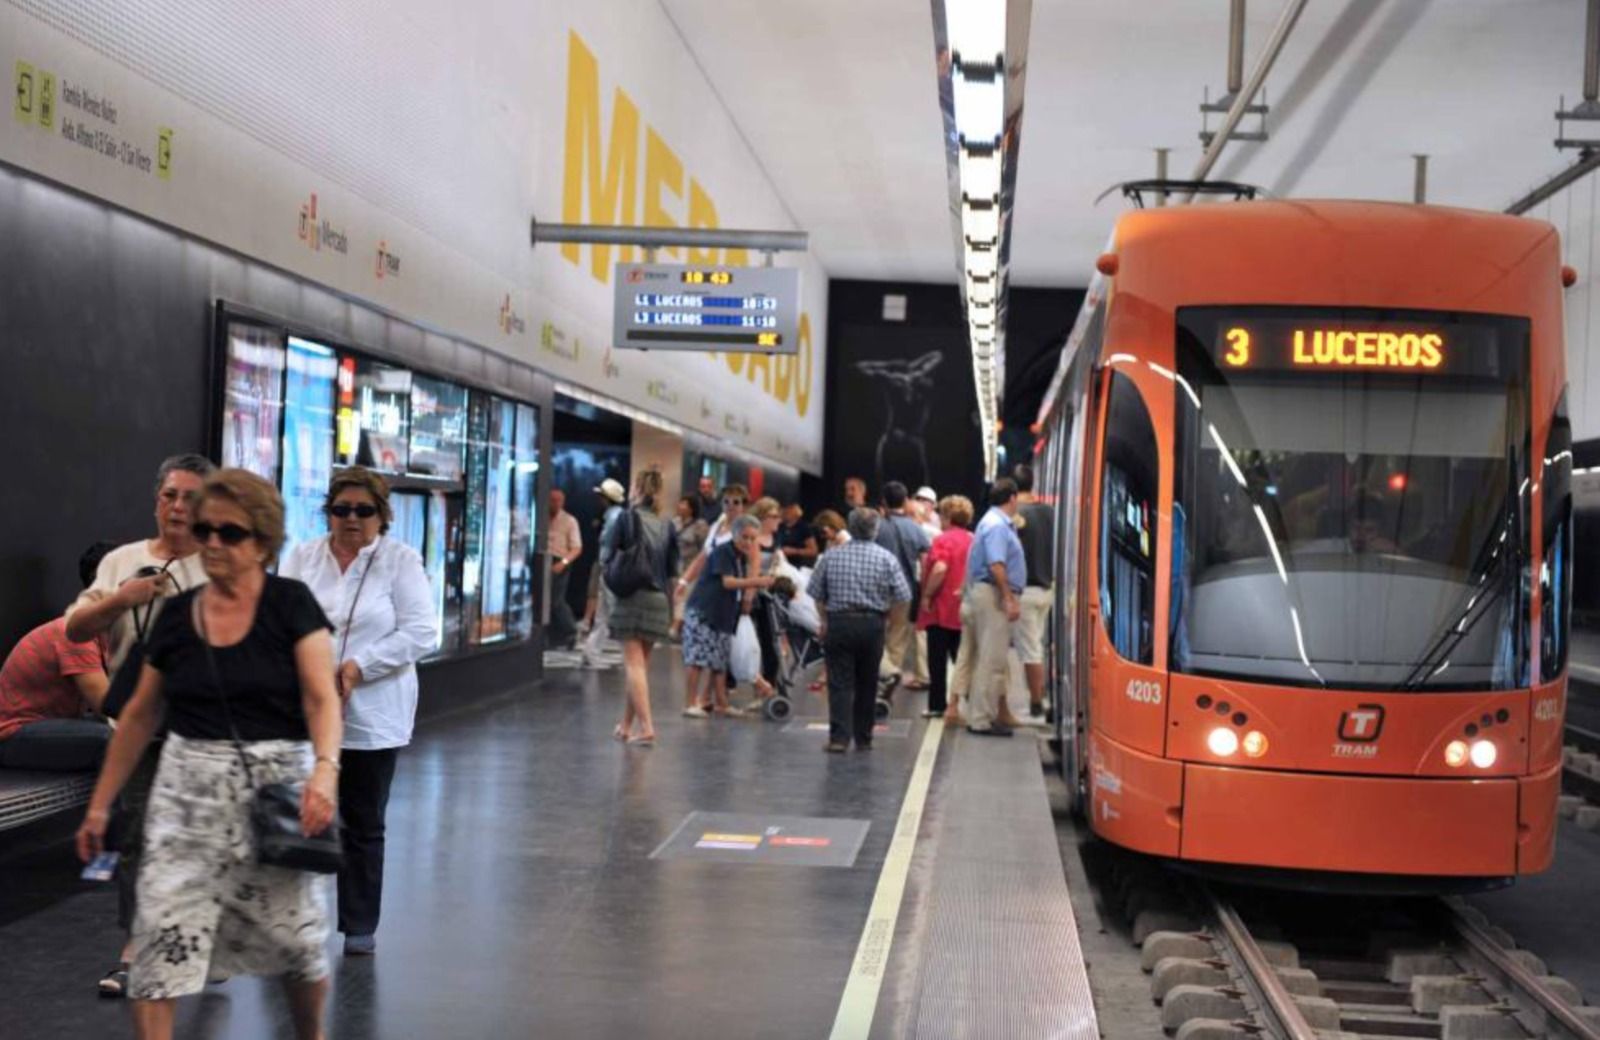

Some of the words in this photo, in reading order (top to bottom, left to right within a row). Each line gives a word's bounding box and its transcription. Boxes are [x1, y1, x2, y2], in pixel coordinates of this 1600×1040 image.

[655, 294, 703, 308] LUCEROS
[655, 312, 702, 326] LUCEROS
[1226, 328, 1250, 366] 3
[1293, 330, 1443, 368] LUCEROS
[1126, 679, 1161, 705] 4203
[1332, 743, 1378, 759] TRAM
